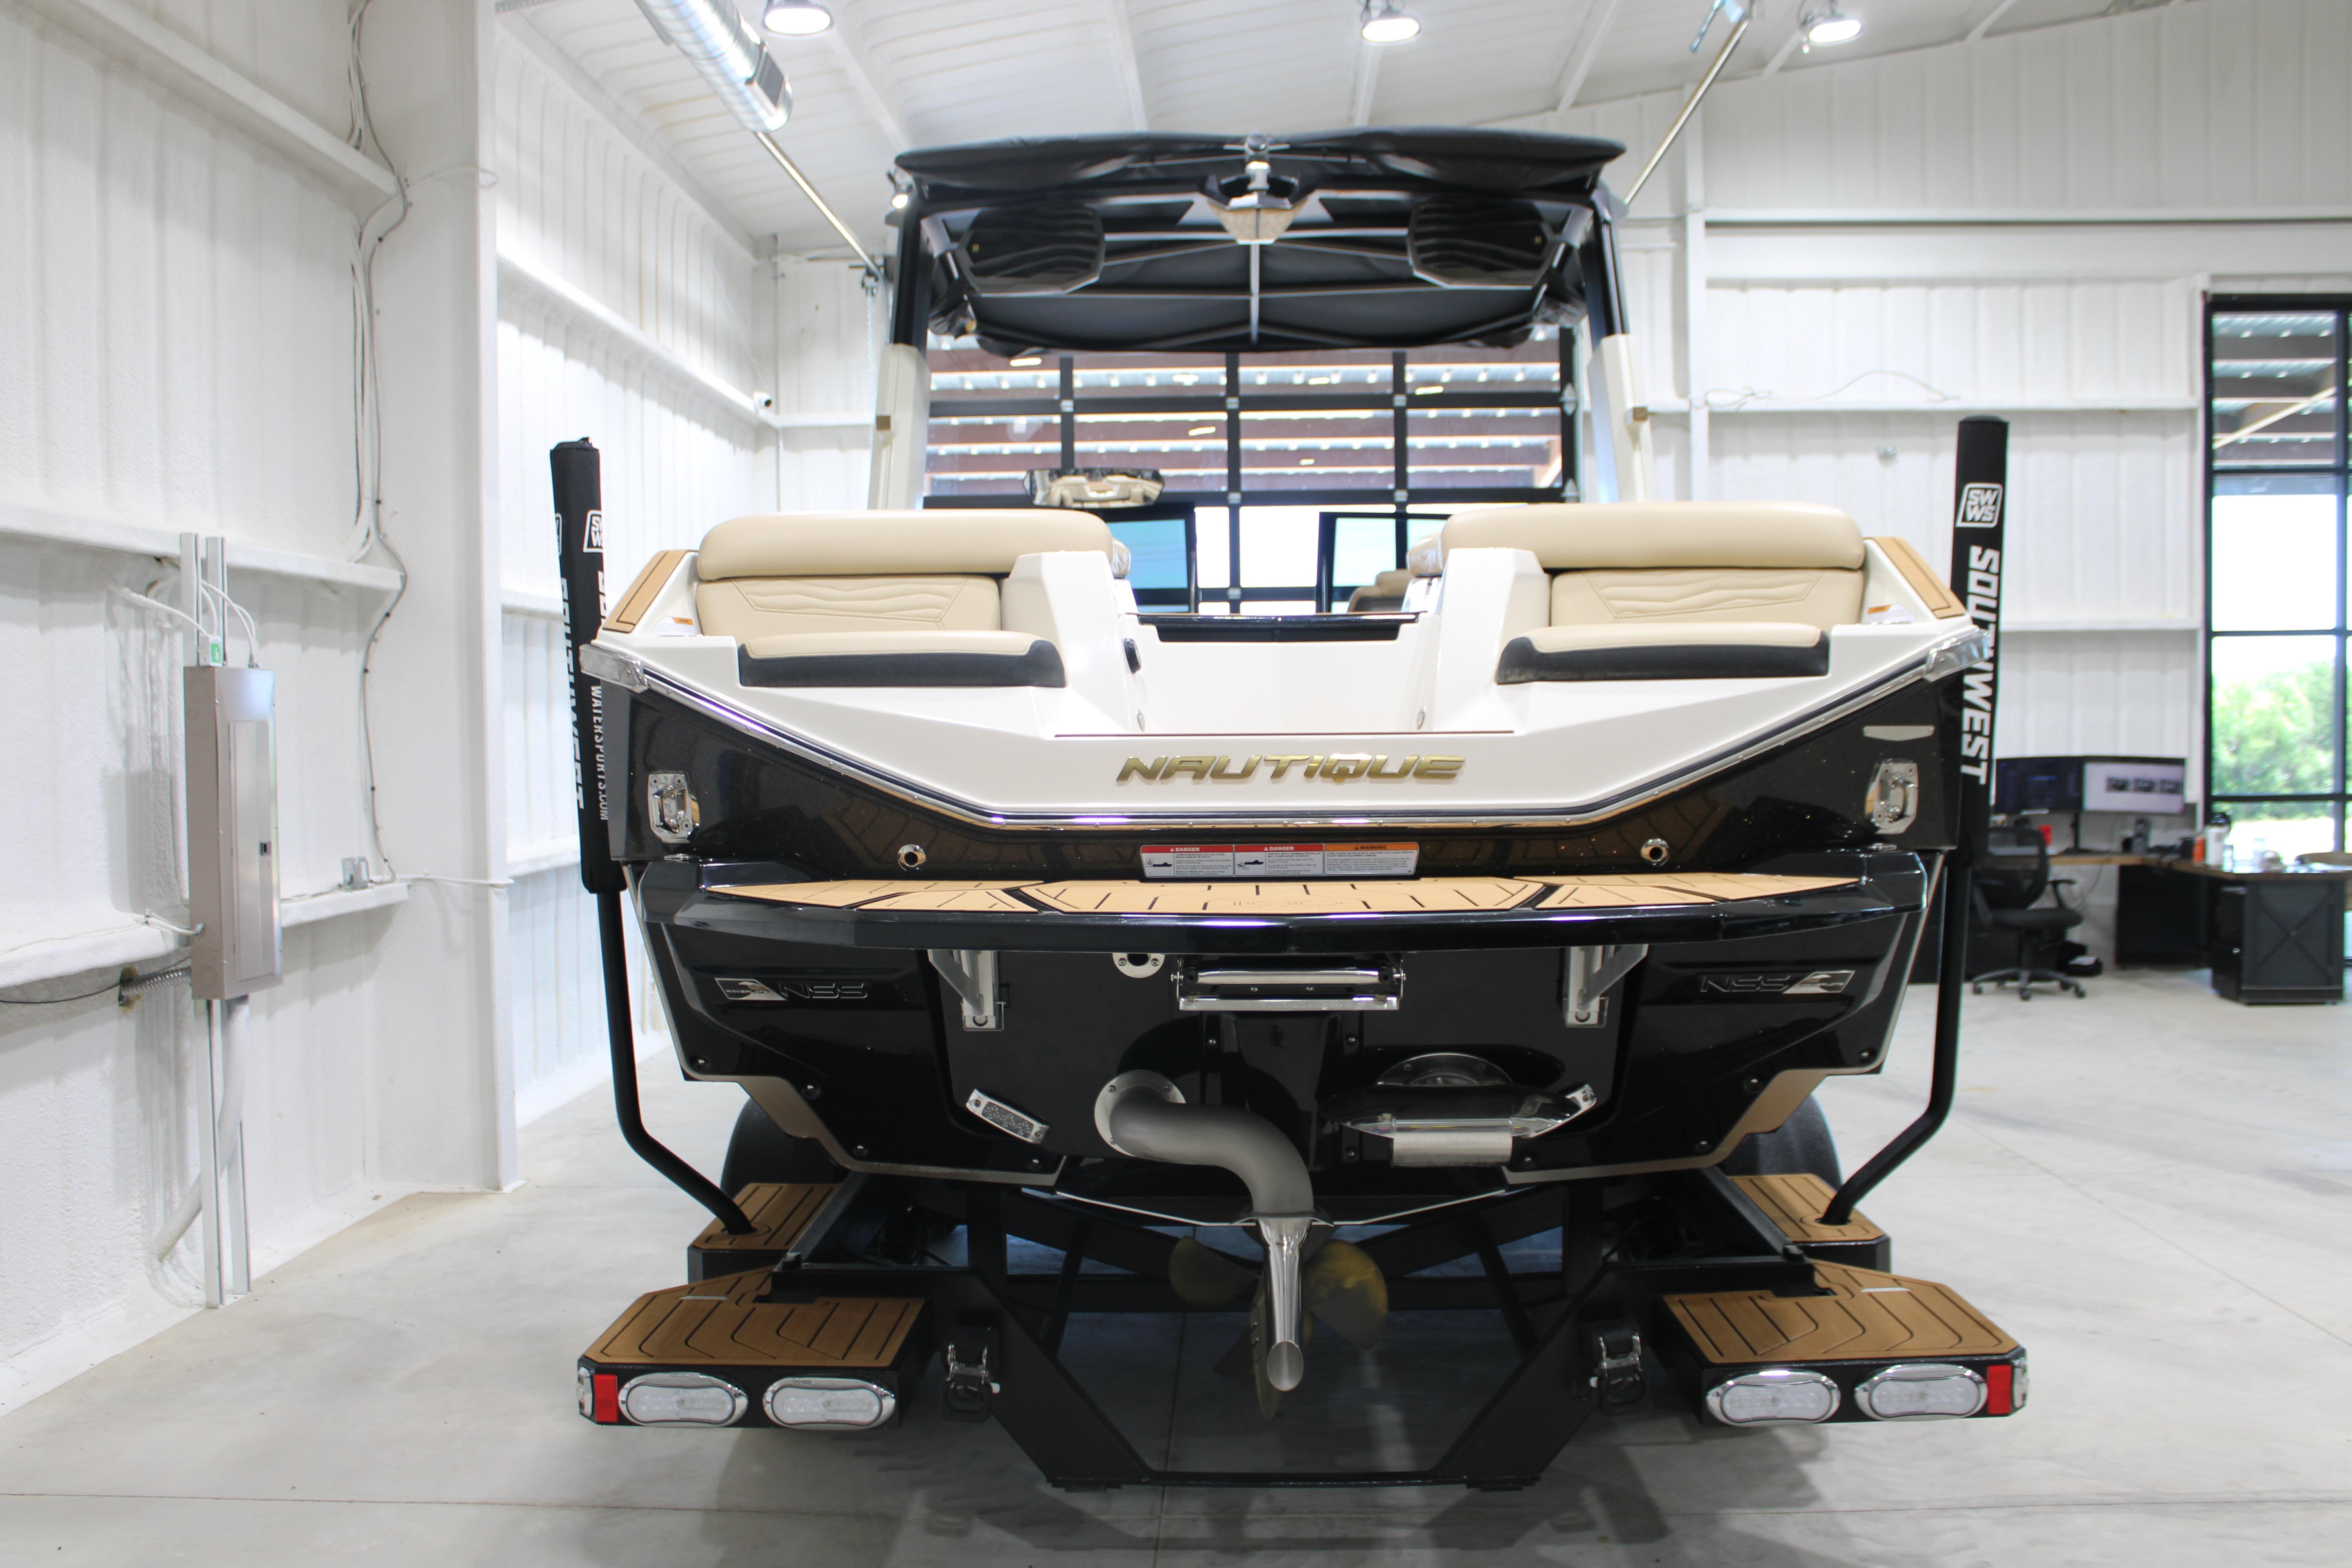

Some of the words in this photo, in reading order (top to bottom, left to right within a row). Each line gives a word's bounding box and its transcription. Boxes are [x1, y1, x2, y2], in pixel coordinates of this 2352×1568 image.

[1967, 489, 1998, 505] SW
[1966, 505, 1996, 521] WS
[591, 531, 603, 547] W
[1116, 754, 1466, 782] NAUTIQUE
